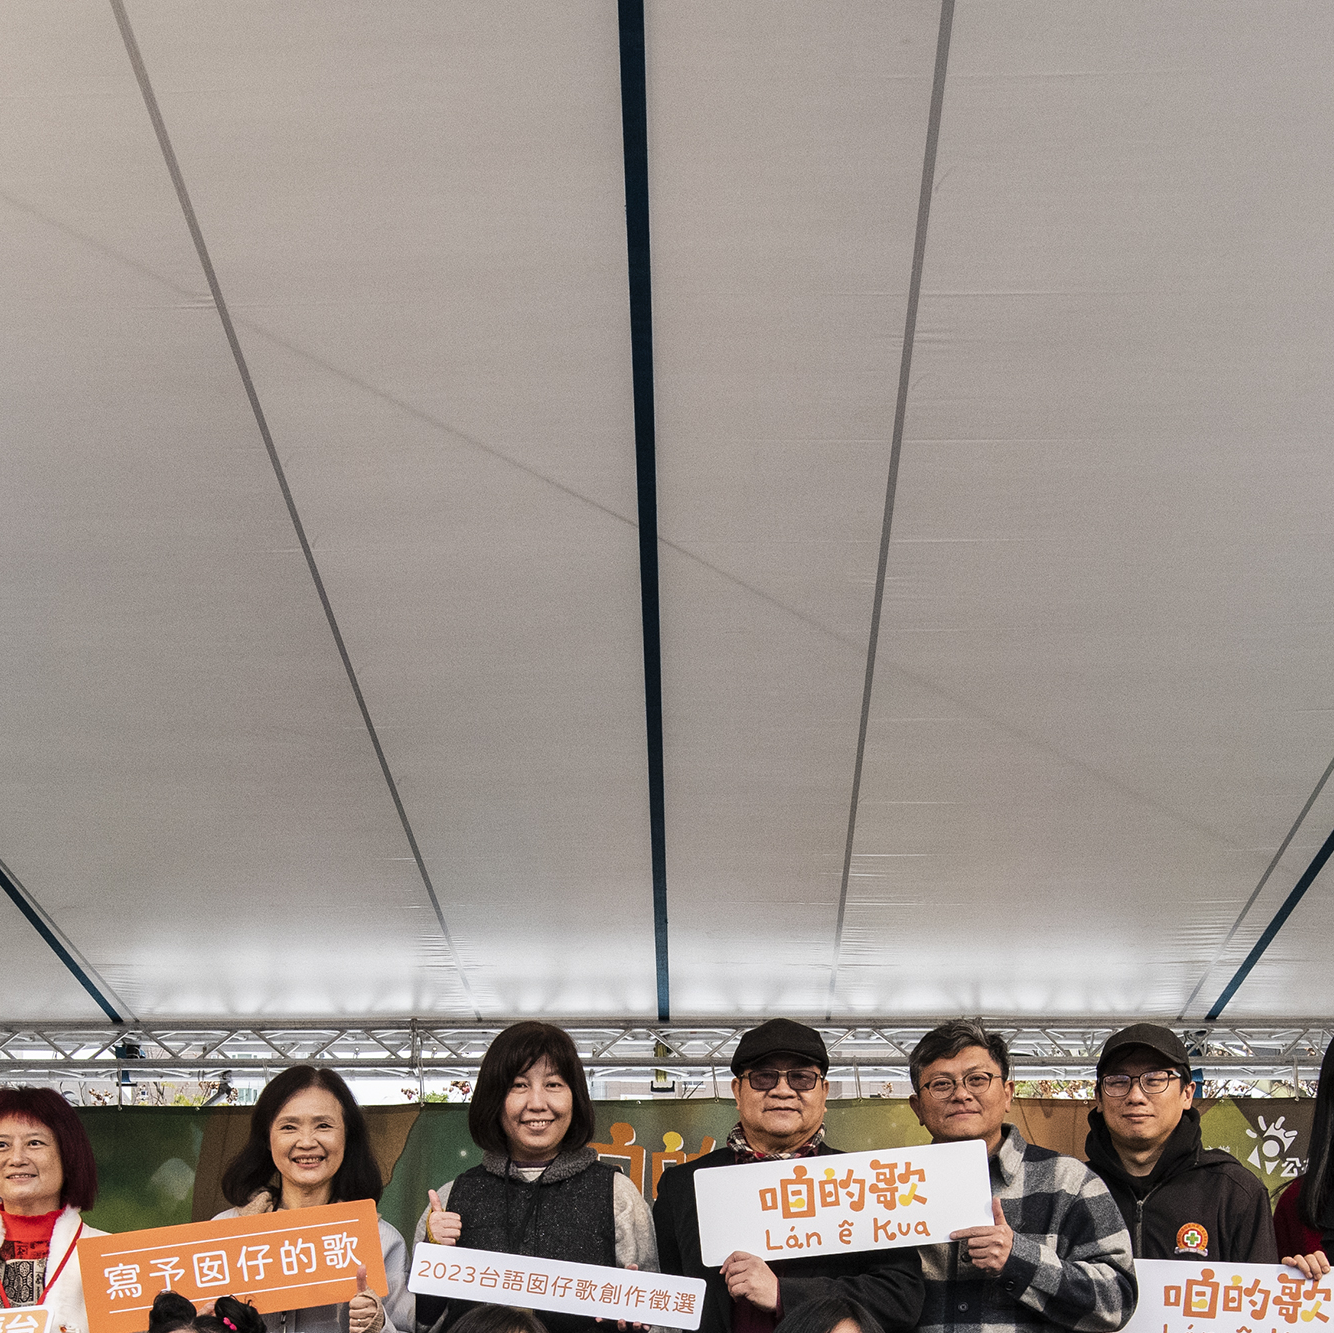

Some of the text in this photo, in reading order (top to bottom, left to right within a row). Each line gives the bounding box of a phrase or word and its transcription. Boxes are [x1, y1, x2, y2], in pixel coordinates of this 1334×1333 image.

[759, 1159, 928, 1219] 咱的歌
[765, 1226, 822, 1251] Lán
[873, 1217, 931, 1242] Kua
[104, 1232, 362, 1300] 寫予囡仔的歌
[417, 1260, 697, 1315] 2023台語囡仔歌創作徵選
[1164, 1268, 1332, 1323] 咱的歌
